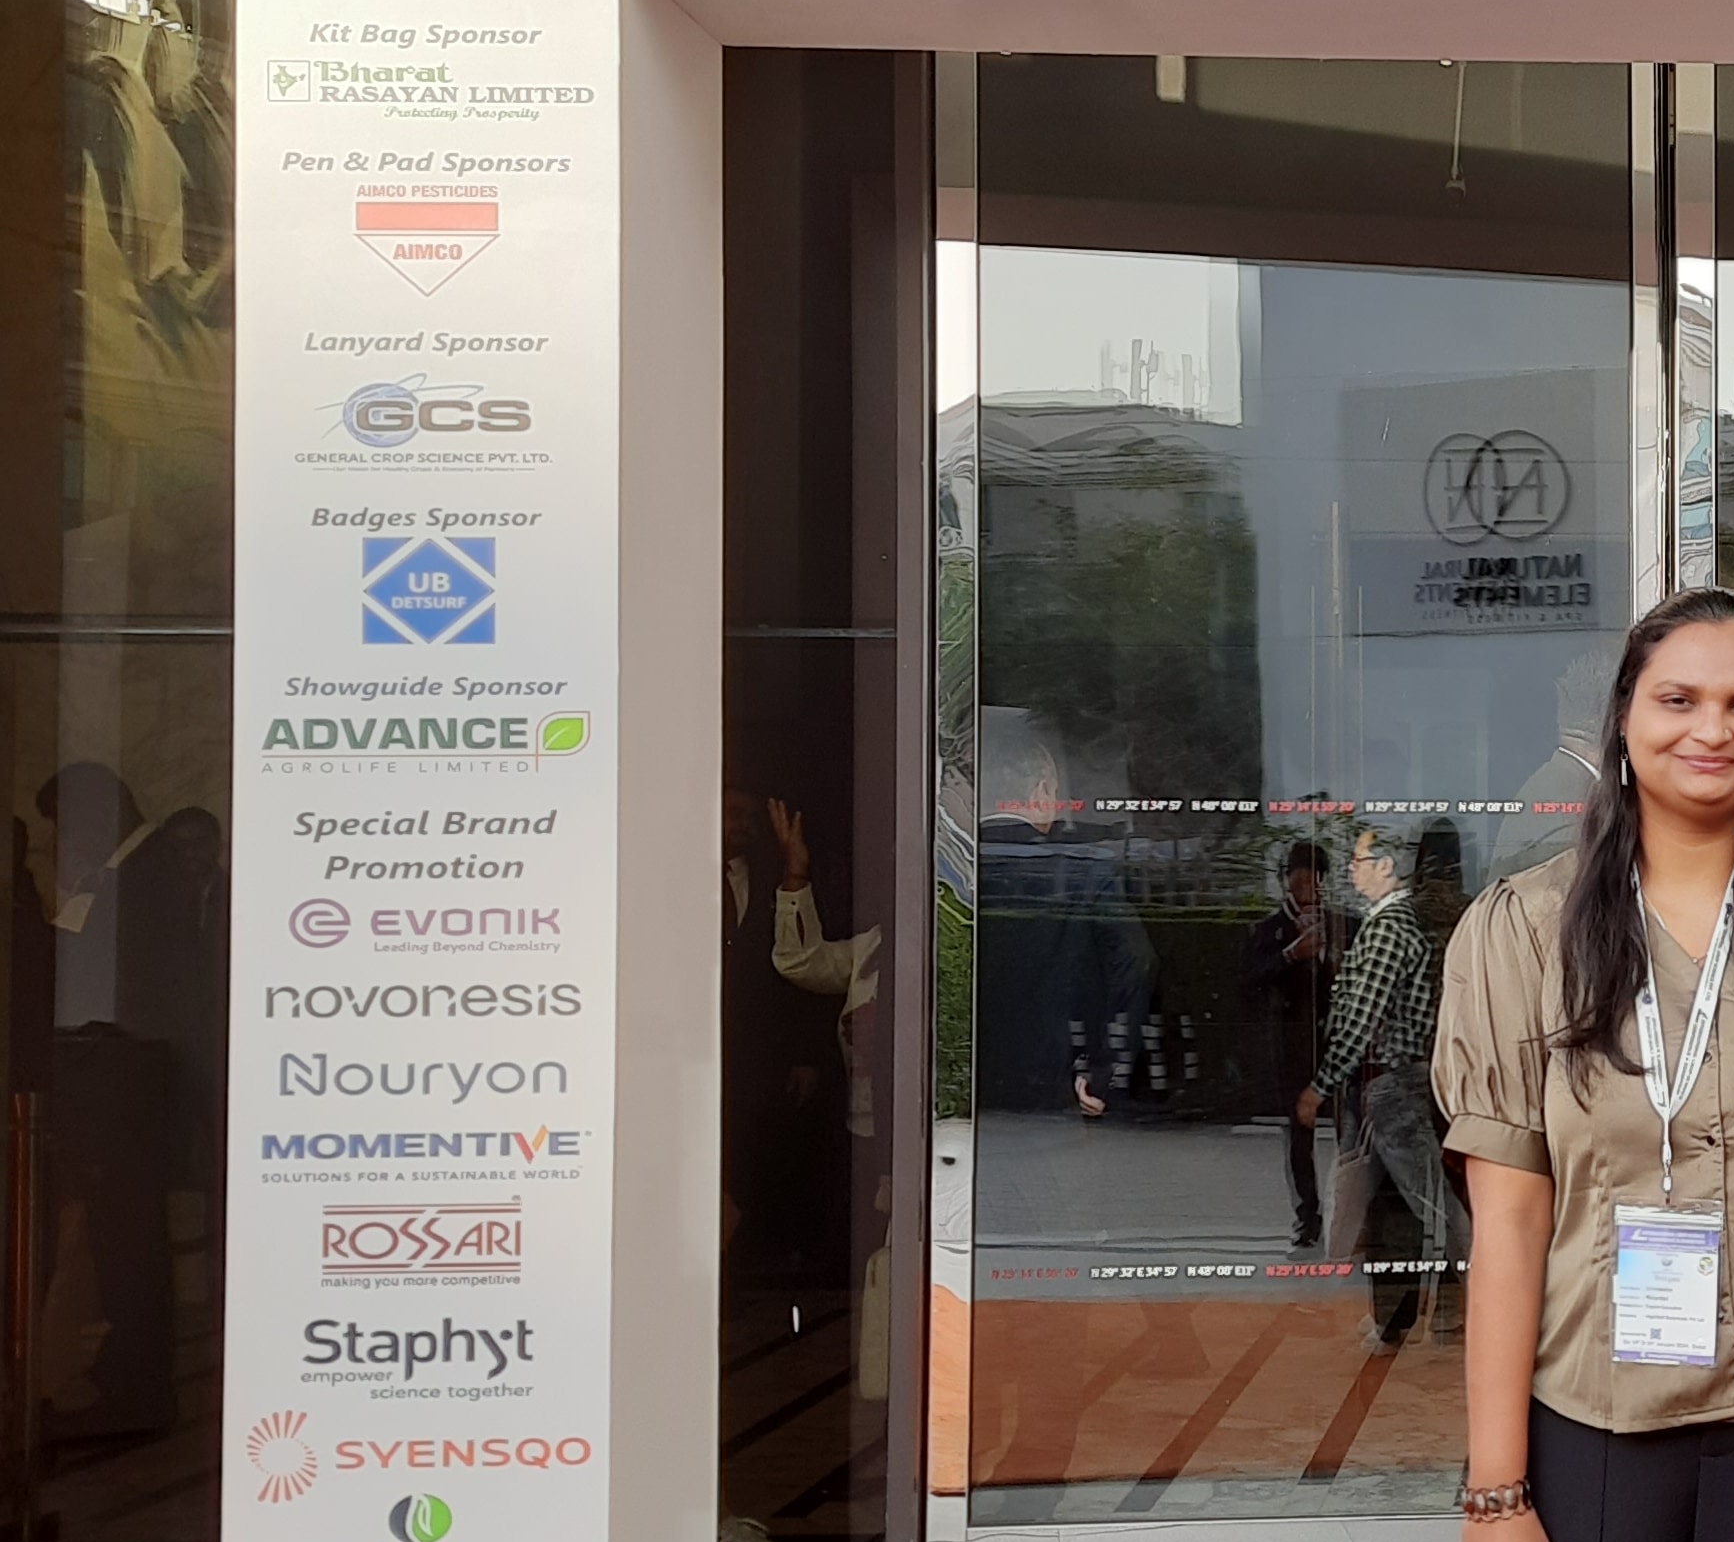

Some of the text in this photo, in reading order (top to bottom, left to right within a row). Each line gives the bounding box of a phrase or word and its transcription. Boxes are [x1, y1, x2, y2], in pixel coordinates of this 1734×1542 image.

[310, 24, 542, 49] Kit Bag Sponsor
[320, 86, 594, 103] RASAYAN LIMITED
[408, 572, 450, 592] UB
[391, 597, 467, 609] DETSURF
[262, 718, 528, 750] ADVANCE
[294, 810, 557, 843] Special Brand
[325, 854, 523, 879] Promotion
[266, 984, 581, 1018] novonesis
[280, 1053, 566, 1104] Nouryon
[321, 1276, 520, 1289] making you more competitive
[303, 1318, 534, 1380] Staphyt
[336, 1438, 591, 1469] SYENSQO
